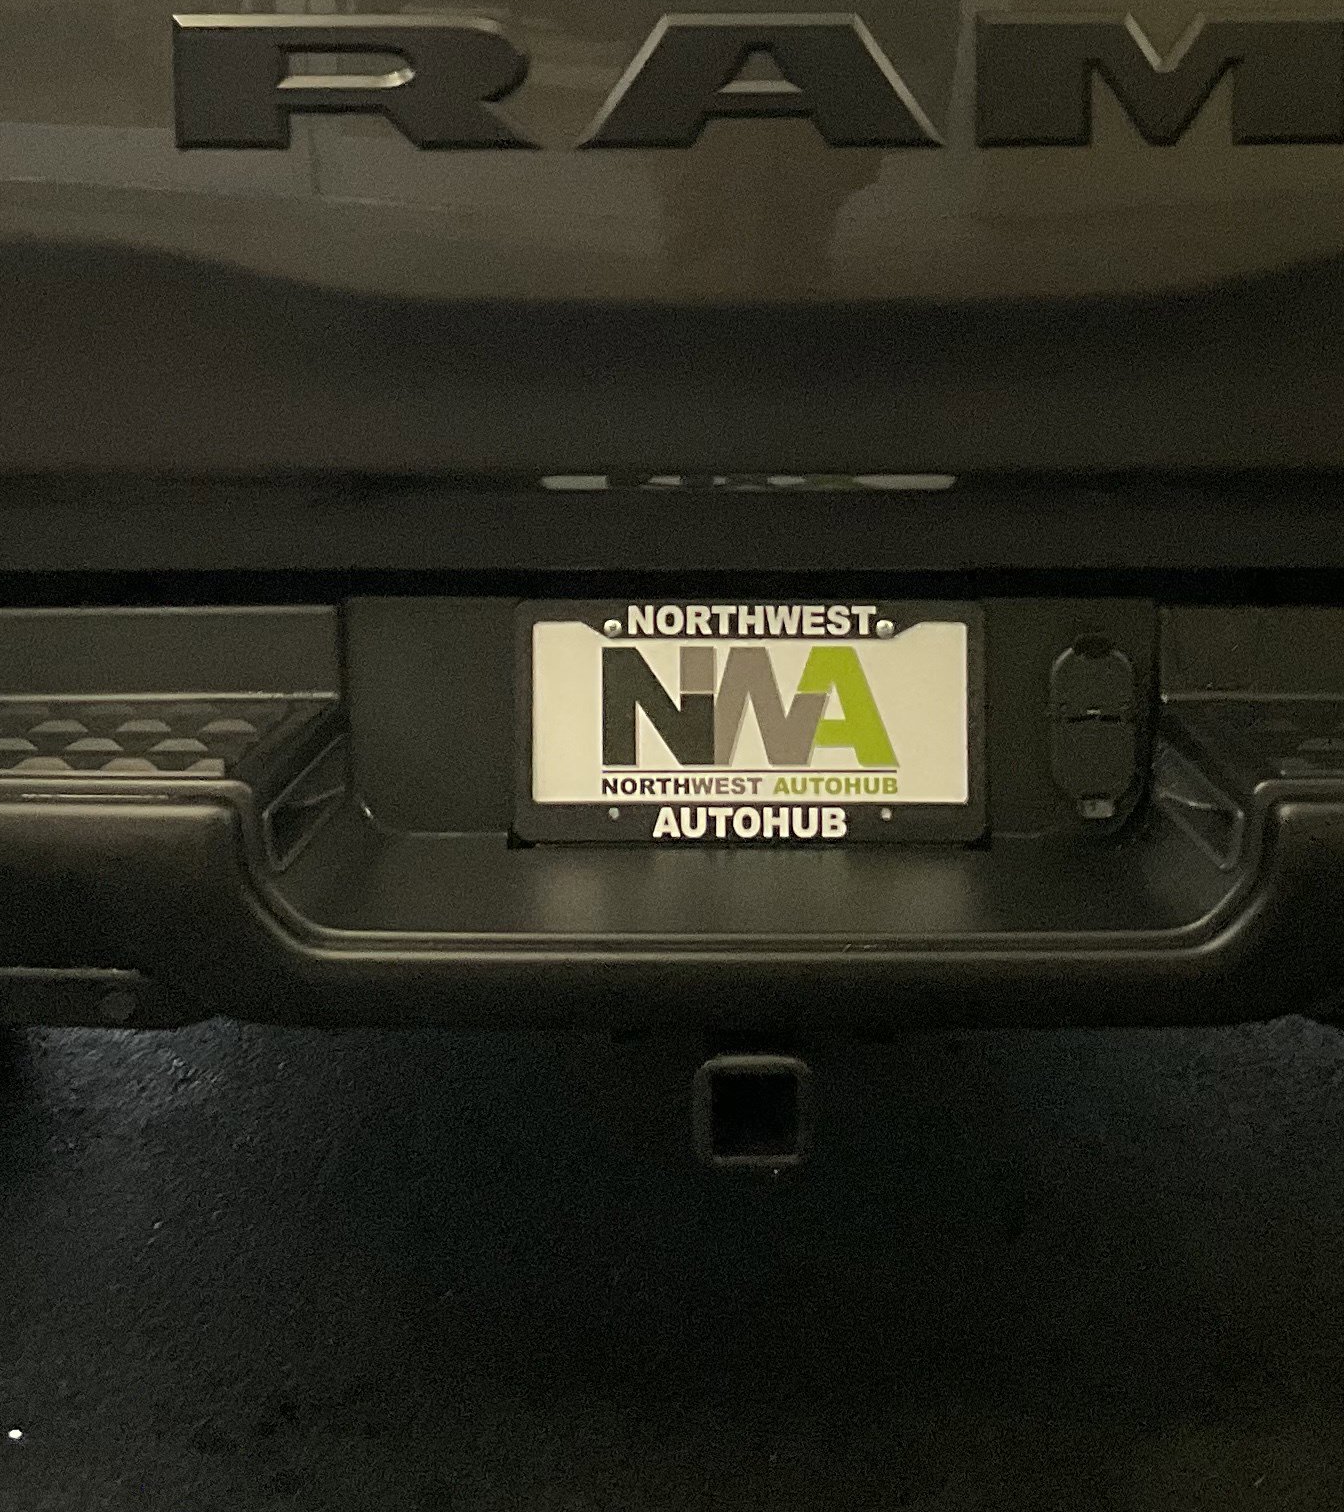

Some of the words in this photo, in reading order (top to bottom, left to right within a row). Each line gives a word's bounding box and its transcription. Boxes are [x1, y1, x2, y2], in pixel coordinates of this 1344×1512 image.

[627, 605, 877, 637] NORTHWEST
[601, 646, 899, 766] NWA
[602, 778, 762, 795] NORTHWEST
[773, 777, 898, 795] AUTOHUB
[652, 806, 847, 838] AUTOHUB
